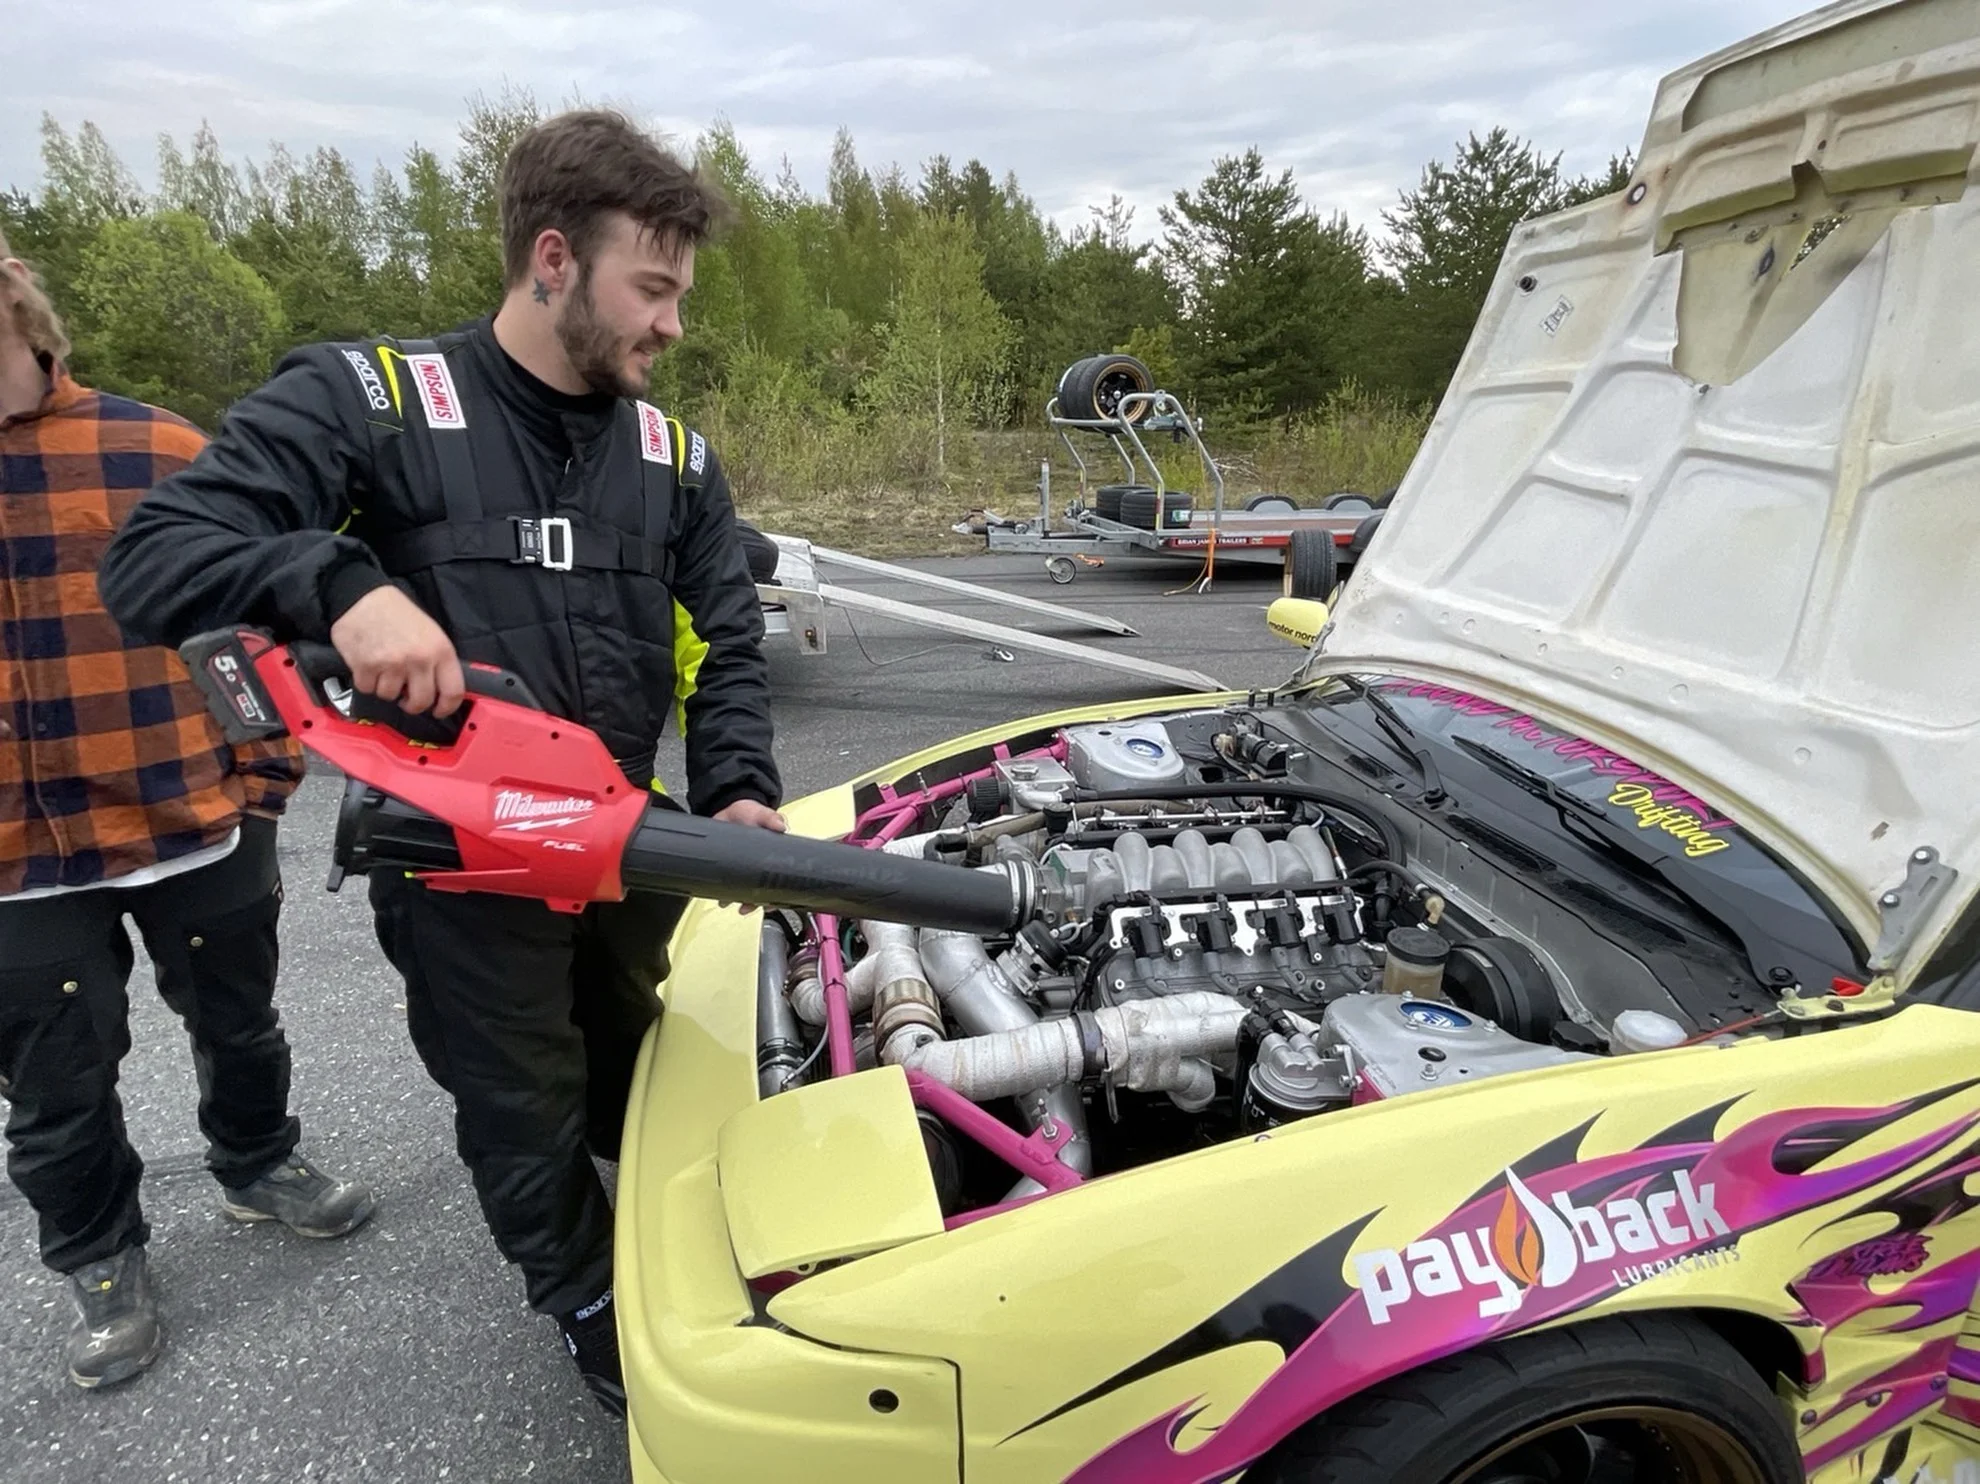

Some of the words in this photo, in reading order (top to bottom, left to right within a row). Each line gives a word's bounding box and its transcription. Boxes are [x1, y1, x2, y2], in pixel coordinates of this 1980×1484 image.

[344, 350, 390, 410] sparco
[419, 363, 453, 419] SIMPSON
[645, 405, 664, 455] SIMPSON
[1268, 621, 1294, 635] motor
[214, 655, 238, 682] 5.0
[494, 789, 596, 821] Milwaukee
[1608, 783, 1730, 857] Drifting
[542, 840, 587, 852] FUEL
[1612, 1244, 1740, 1287] LUBRICANTS
